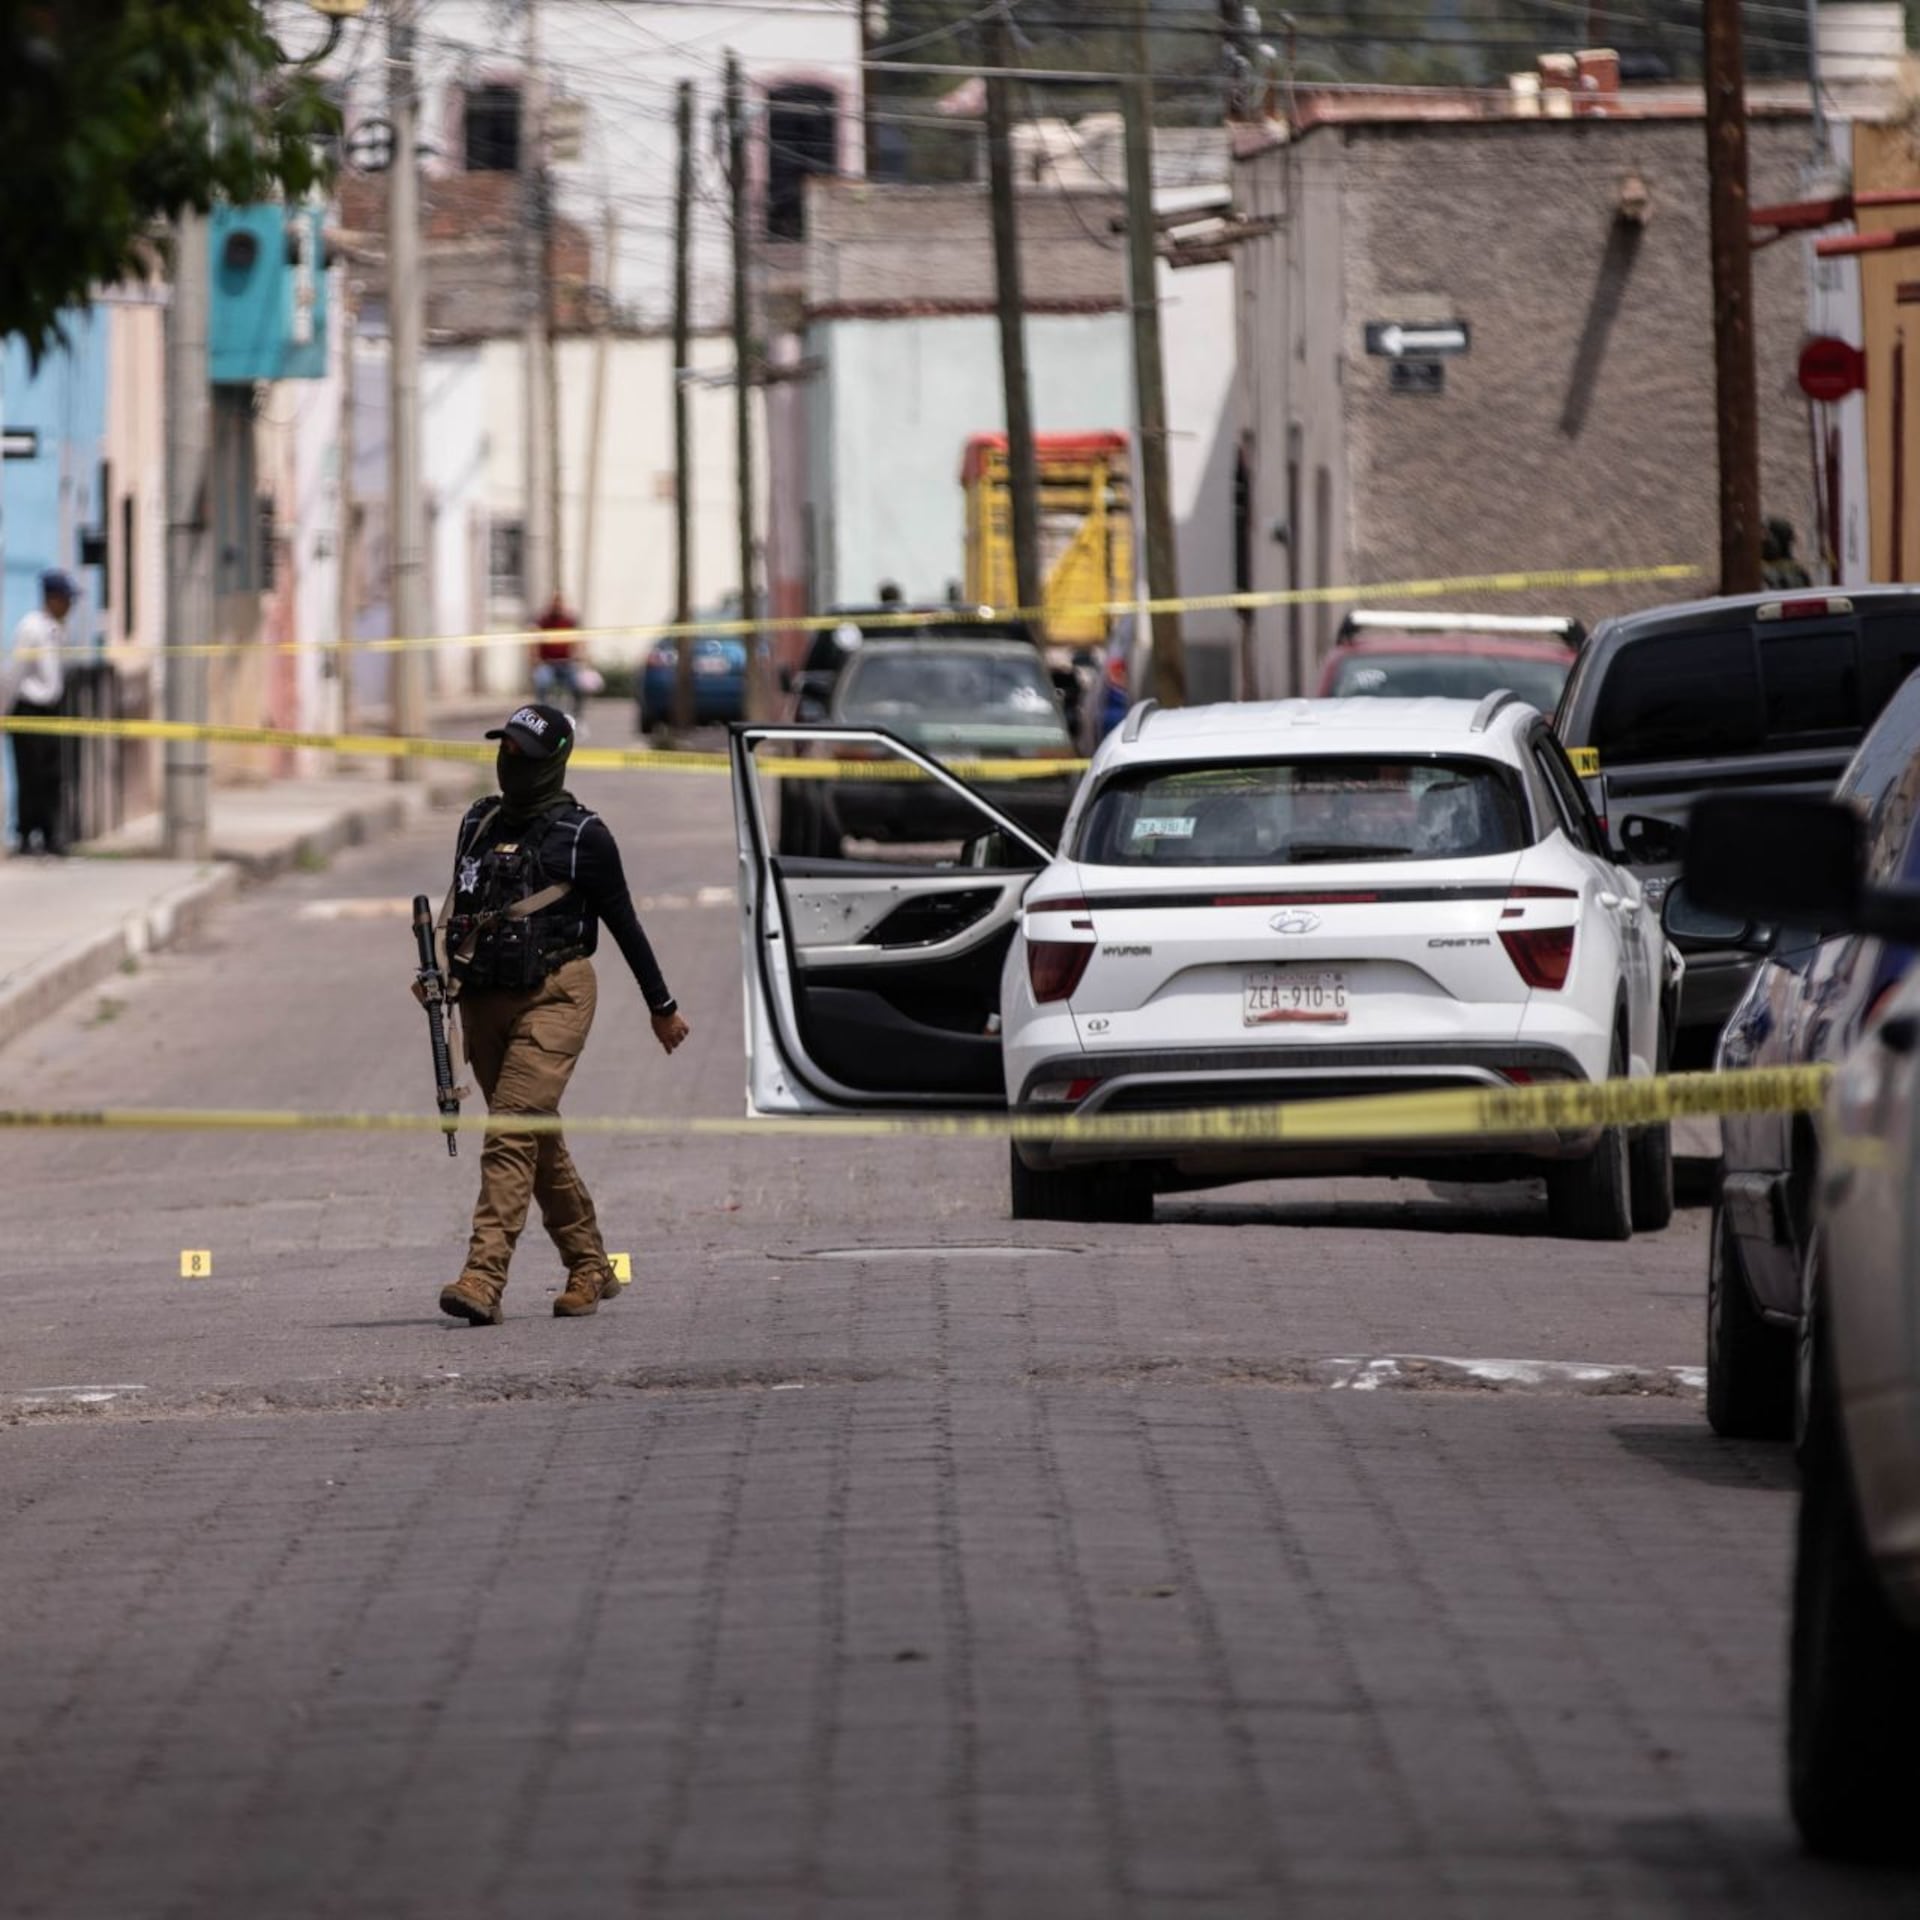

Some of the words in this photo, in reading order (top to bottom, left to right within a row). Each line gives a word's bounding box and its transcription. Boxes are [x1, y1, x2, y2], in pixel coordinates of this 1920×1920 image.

[1428, 938, 1490, 948] CRETA
[1102, 945, 1152, 957] HYUNDAI
[1247, 985, 1345, 1009] ZEA-910-G
[192, 1255, 201, 1271] 8
